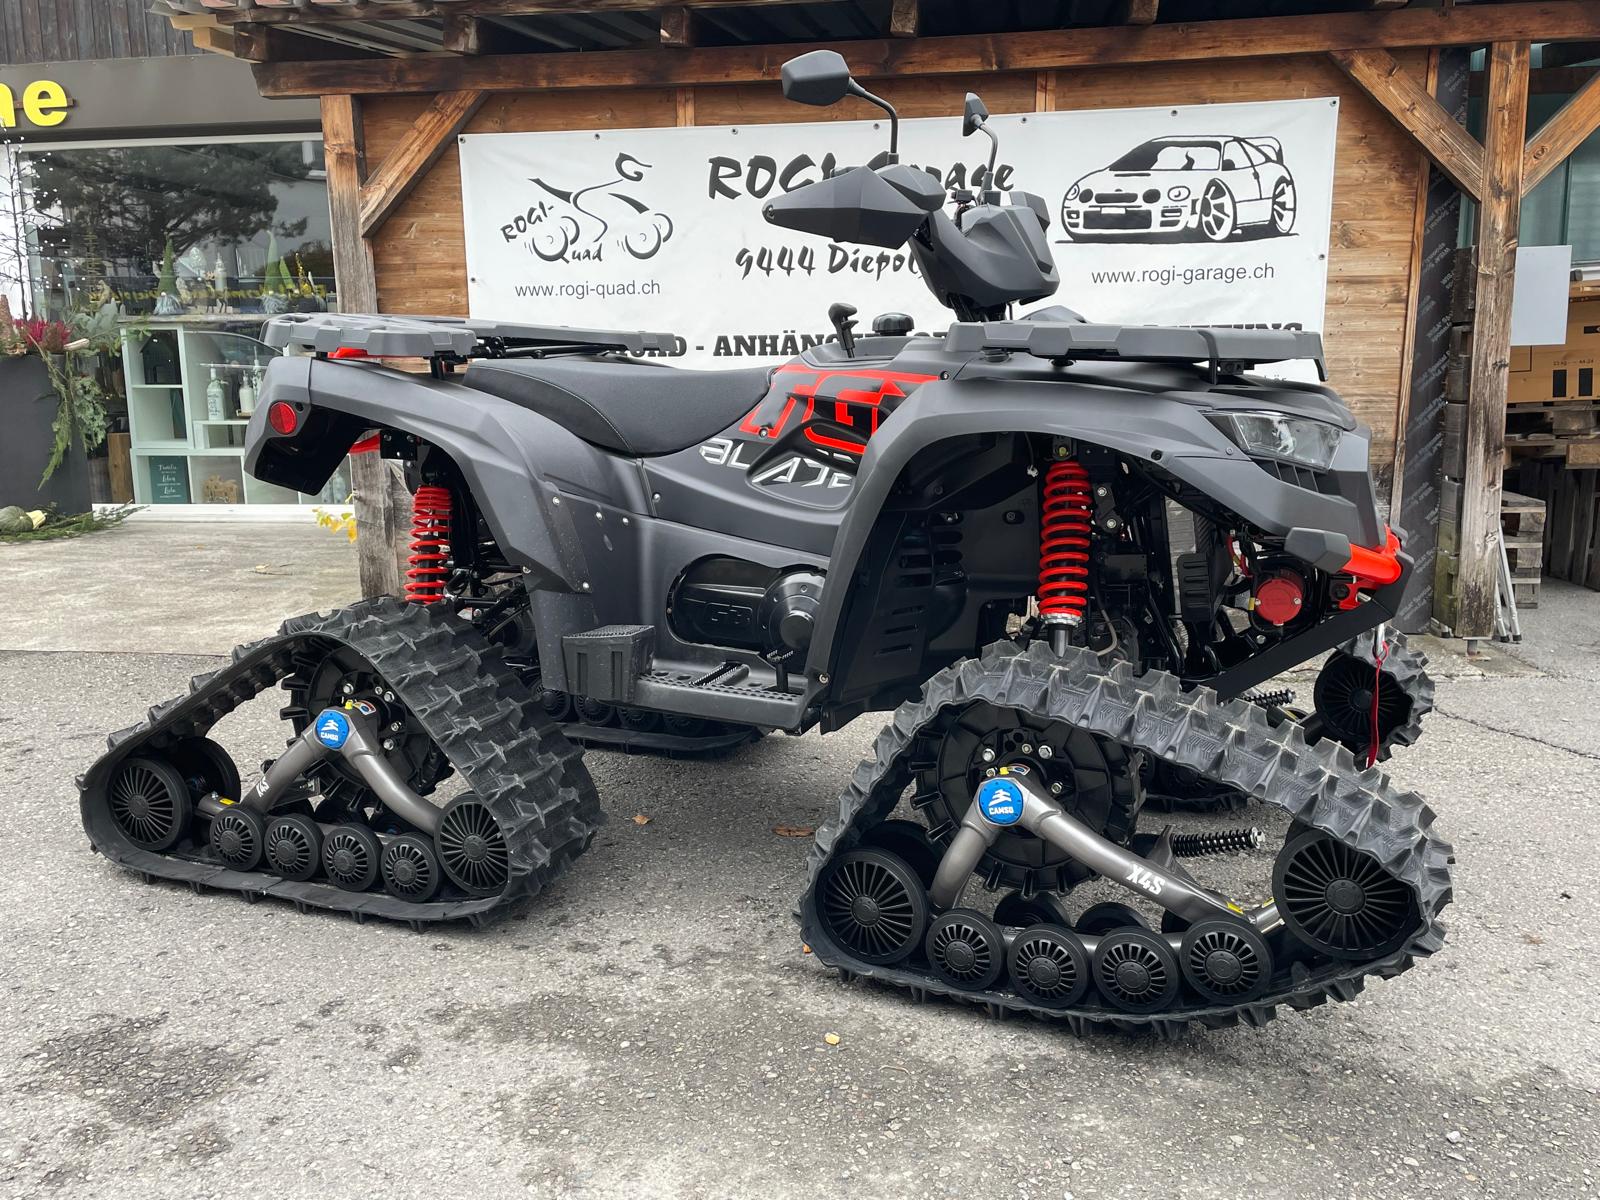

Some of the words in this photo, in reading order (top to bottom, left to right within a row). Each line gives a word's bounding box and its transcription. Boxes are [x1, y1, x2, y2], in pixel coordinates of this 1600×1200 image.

[735, 246, 816, 281] 9444
[1091, 262, 1275, 286] www.rogi-garage.ch
[515, 280, 661, 299] www.rogi-quad.ch
[988, 806, 1014, 815] CAMSO
[1126, 862, 1166, 895] X4S
